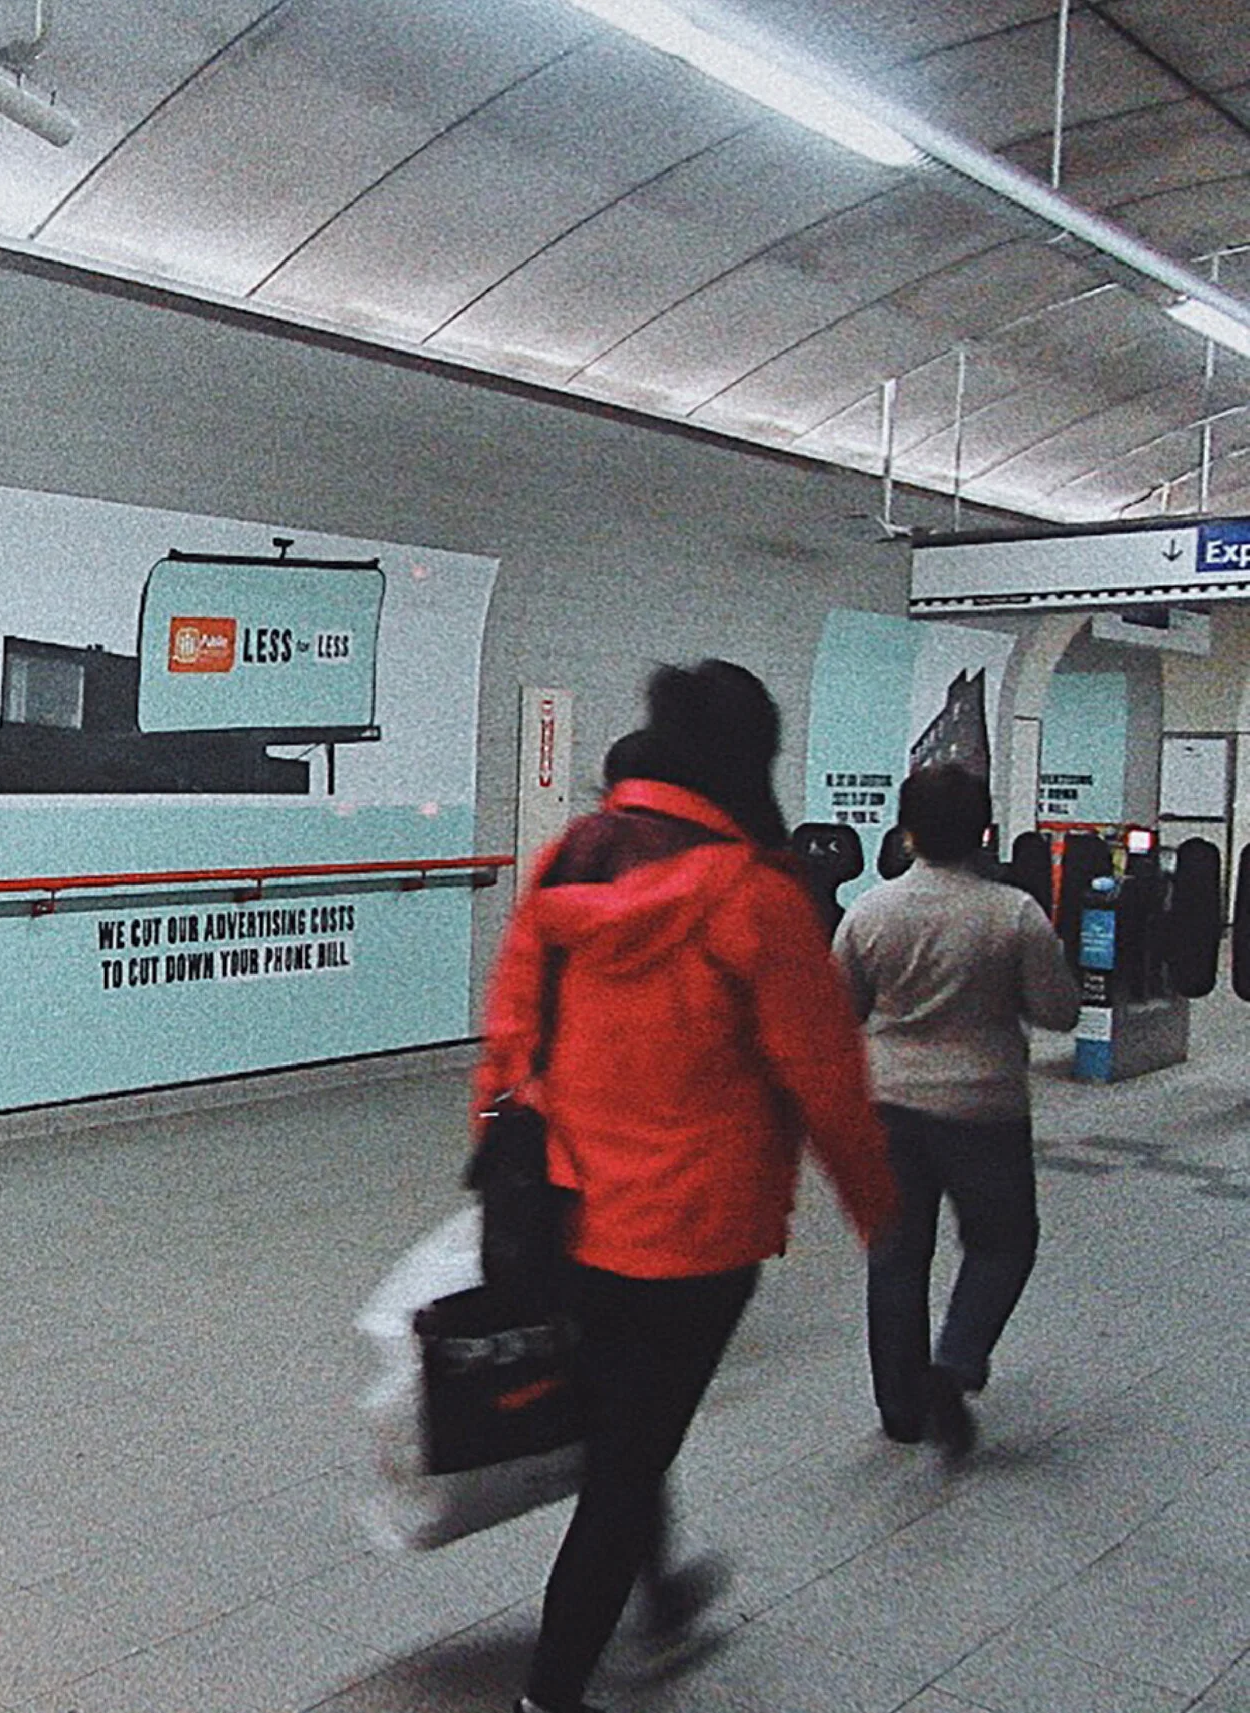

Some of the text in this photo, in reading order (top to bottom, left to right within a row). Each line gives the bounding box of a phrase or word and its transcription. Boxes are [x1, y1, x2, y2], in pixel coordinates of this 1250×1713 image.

[243, 628, 293, 663] LESS
[318, 634, 350, 659] LESS
[99, 904, 355, 950] WE CUT OUR ADVERTISING COSTS
[102, 941, 350, 990] TO CUT DOWN YOUR PHONE BILL
